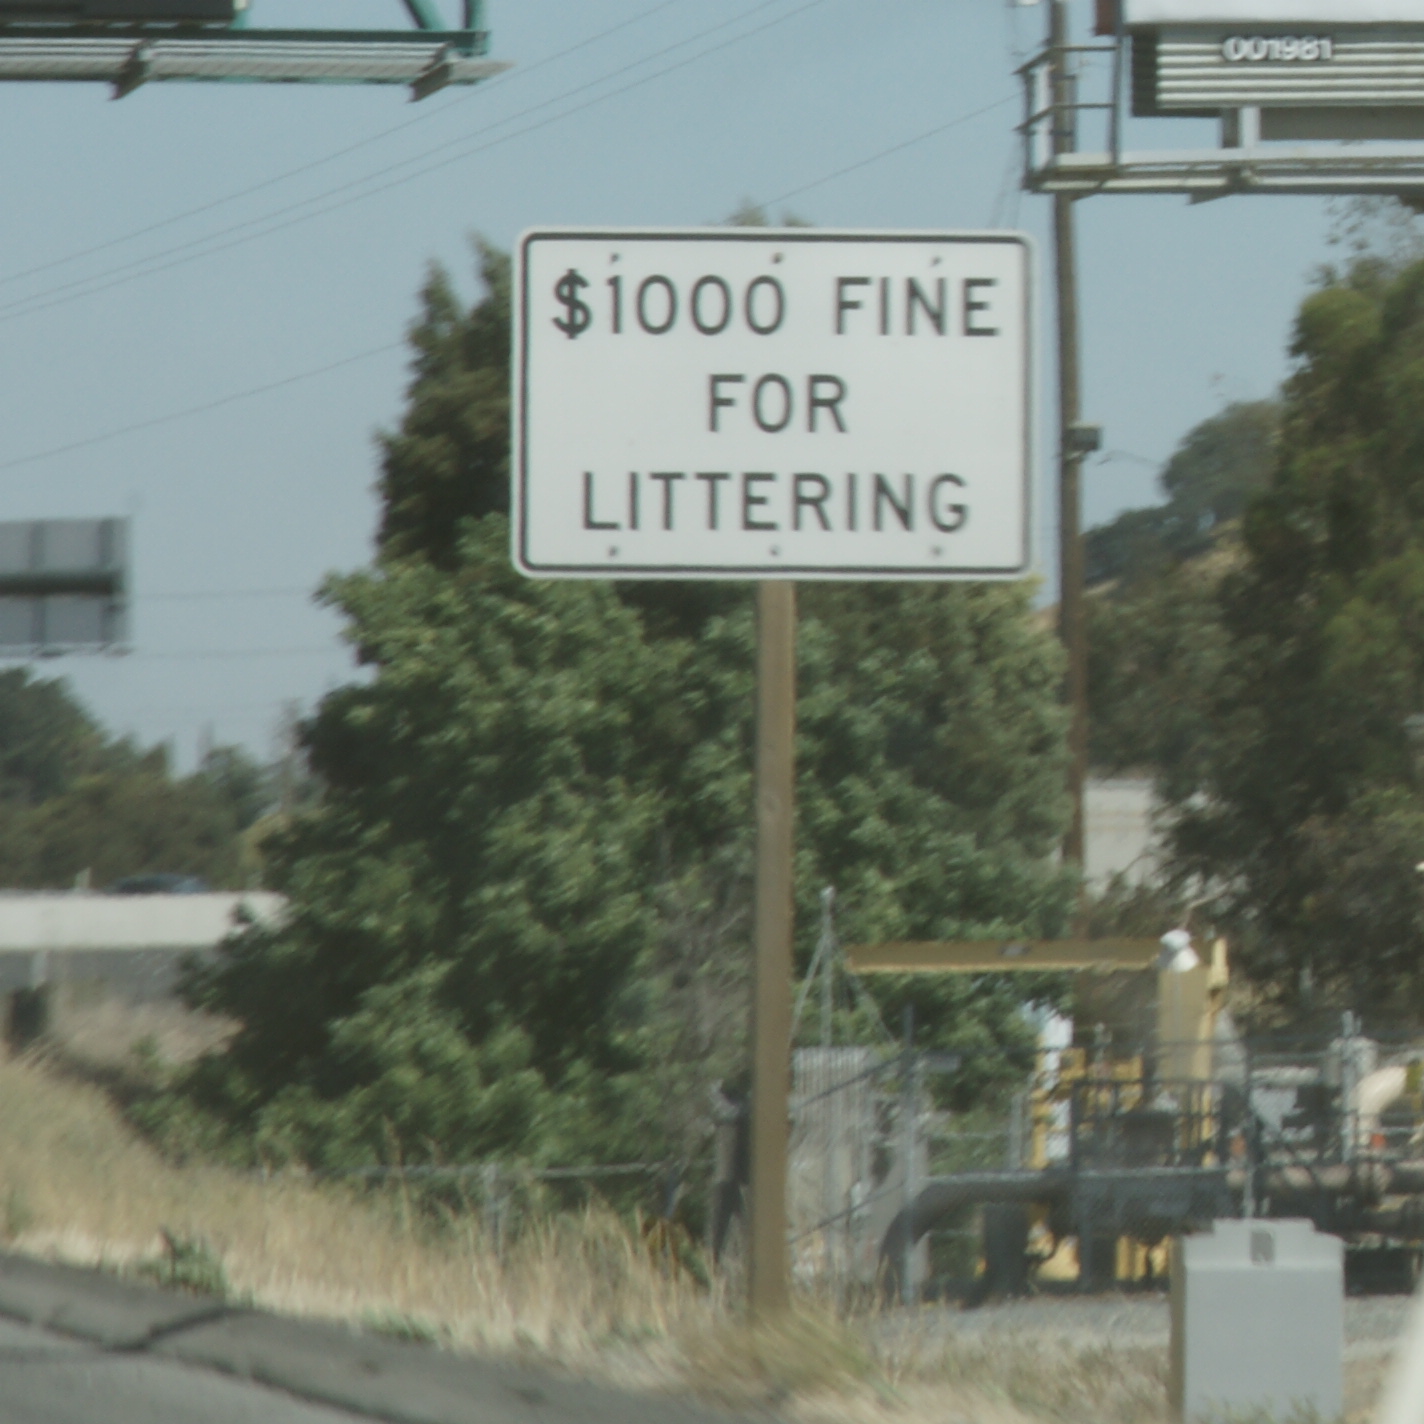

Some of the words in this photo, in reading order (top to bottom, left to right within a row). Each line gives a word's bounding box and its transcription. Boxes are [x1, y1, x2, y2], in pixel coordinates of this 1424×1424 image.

[1222, 36, 1332, 61] 001981
[551, 267, 787, 339] $1000
[834, 275, 1001, 338] FINE
[706, 372, 850, 434] FOR
[582, 470, 969, 533] LITTERING
